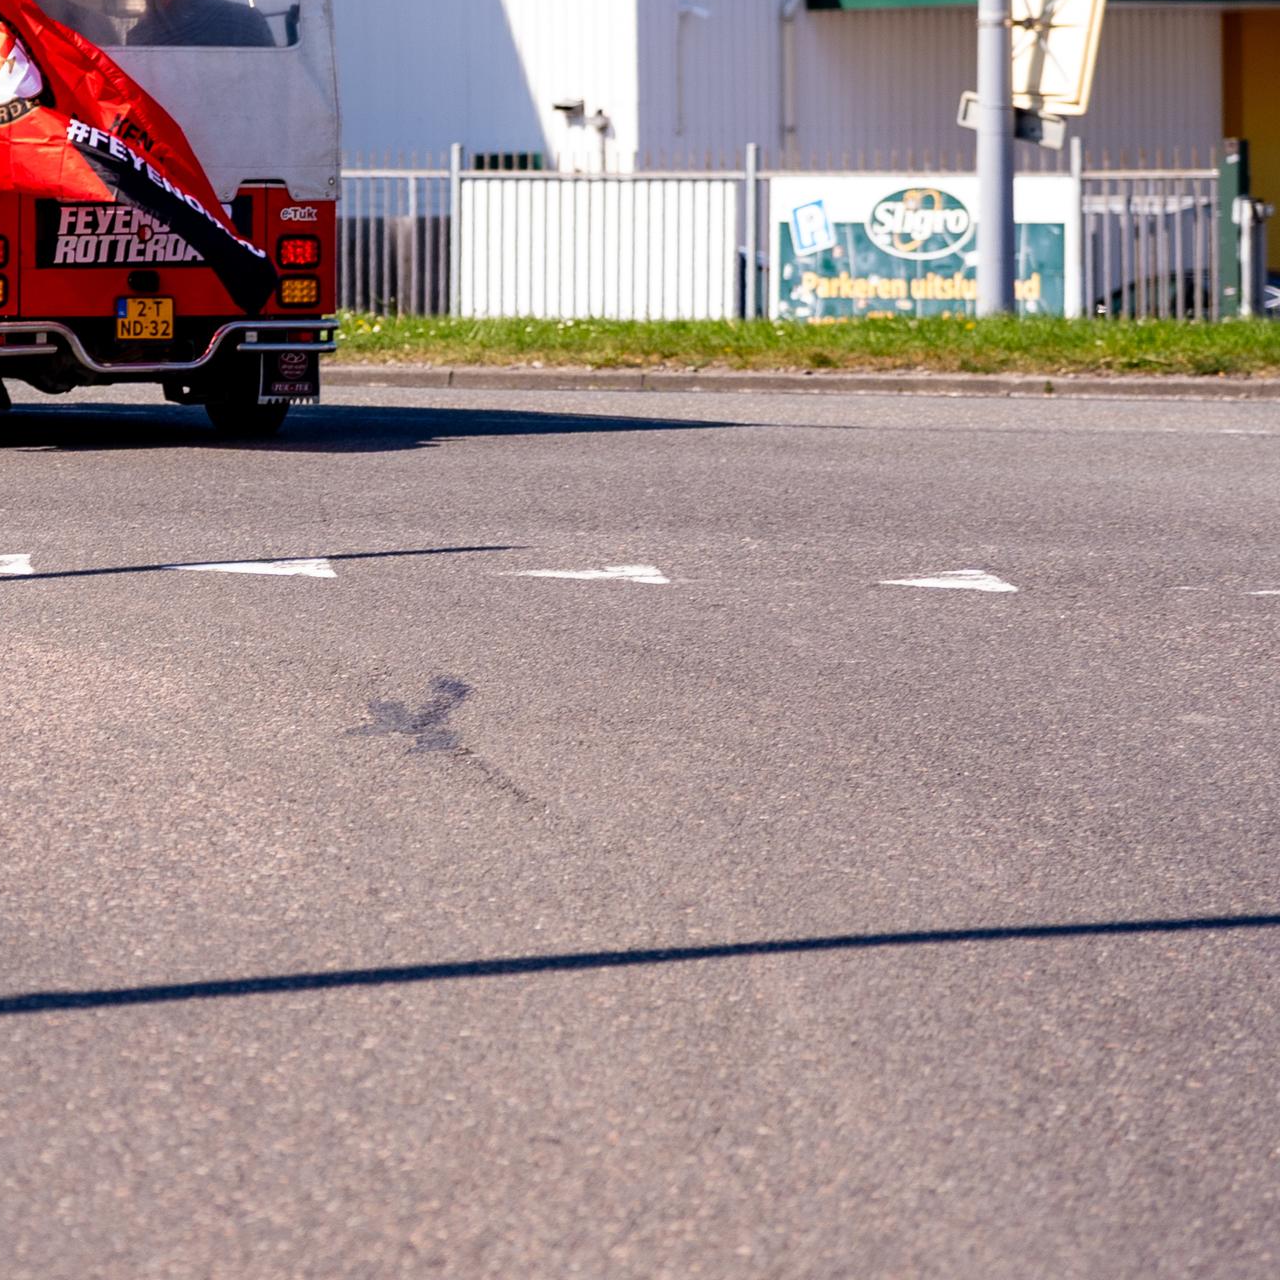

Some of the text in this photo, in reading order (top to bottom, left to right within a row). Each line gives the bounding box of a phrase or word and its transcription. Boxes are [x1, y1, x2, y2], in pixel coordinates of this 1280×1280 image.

[280, 206, 318, 221] e-Tuk
[872, 201, 970, 241] Sligro
[53, 233, 205, 264] ROTTERDA
[801, 271, 908, 300] Parkeren
[137, 300, 163, 317] 2-T
[120, 320, 171, 337] ND-32
